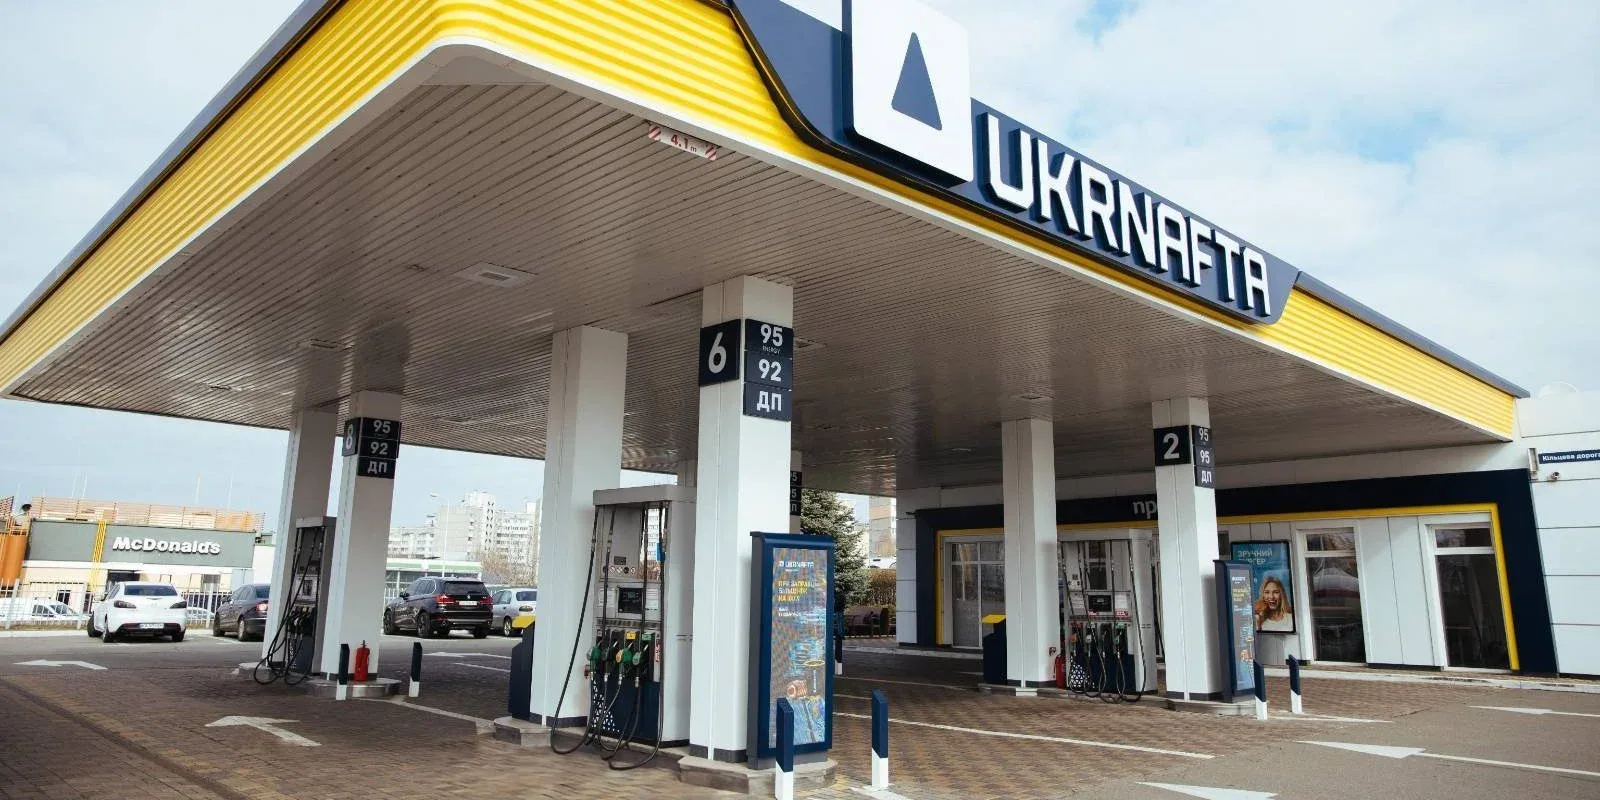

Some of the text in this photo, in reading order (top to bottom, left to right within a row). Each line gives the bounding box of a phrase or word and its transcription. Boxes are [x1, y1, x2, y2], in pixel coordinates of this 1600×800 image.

[670, 134, 689, 149] 4.1
[979, 112, 1271, 317] UKRNAFTA
[760, 324, 783, 347] 95
[708, 331, 727, 374] 6
[758, 358, 782, 382] 92
[756, 391, 782, 413] ДП
[373, 419, 391, 434] 95
[1199, 427, 1209, 442] 95
[345, 423, 354, 450] 8
[1162, 432, 1180, 460] 2
[370, 441, 389, 455] 92
[1200, 449, 1210, 464] 95
[367, 460, 388, 475] ДП
[1201, 470, 1212, 484] ДП
[112, 536, 221, 555] McDonald's
